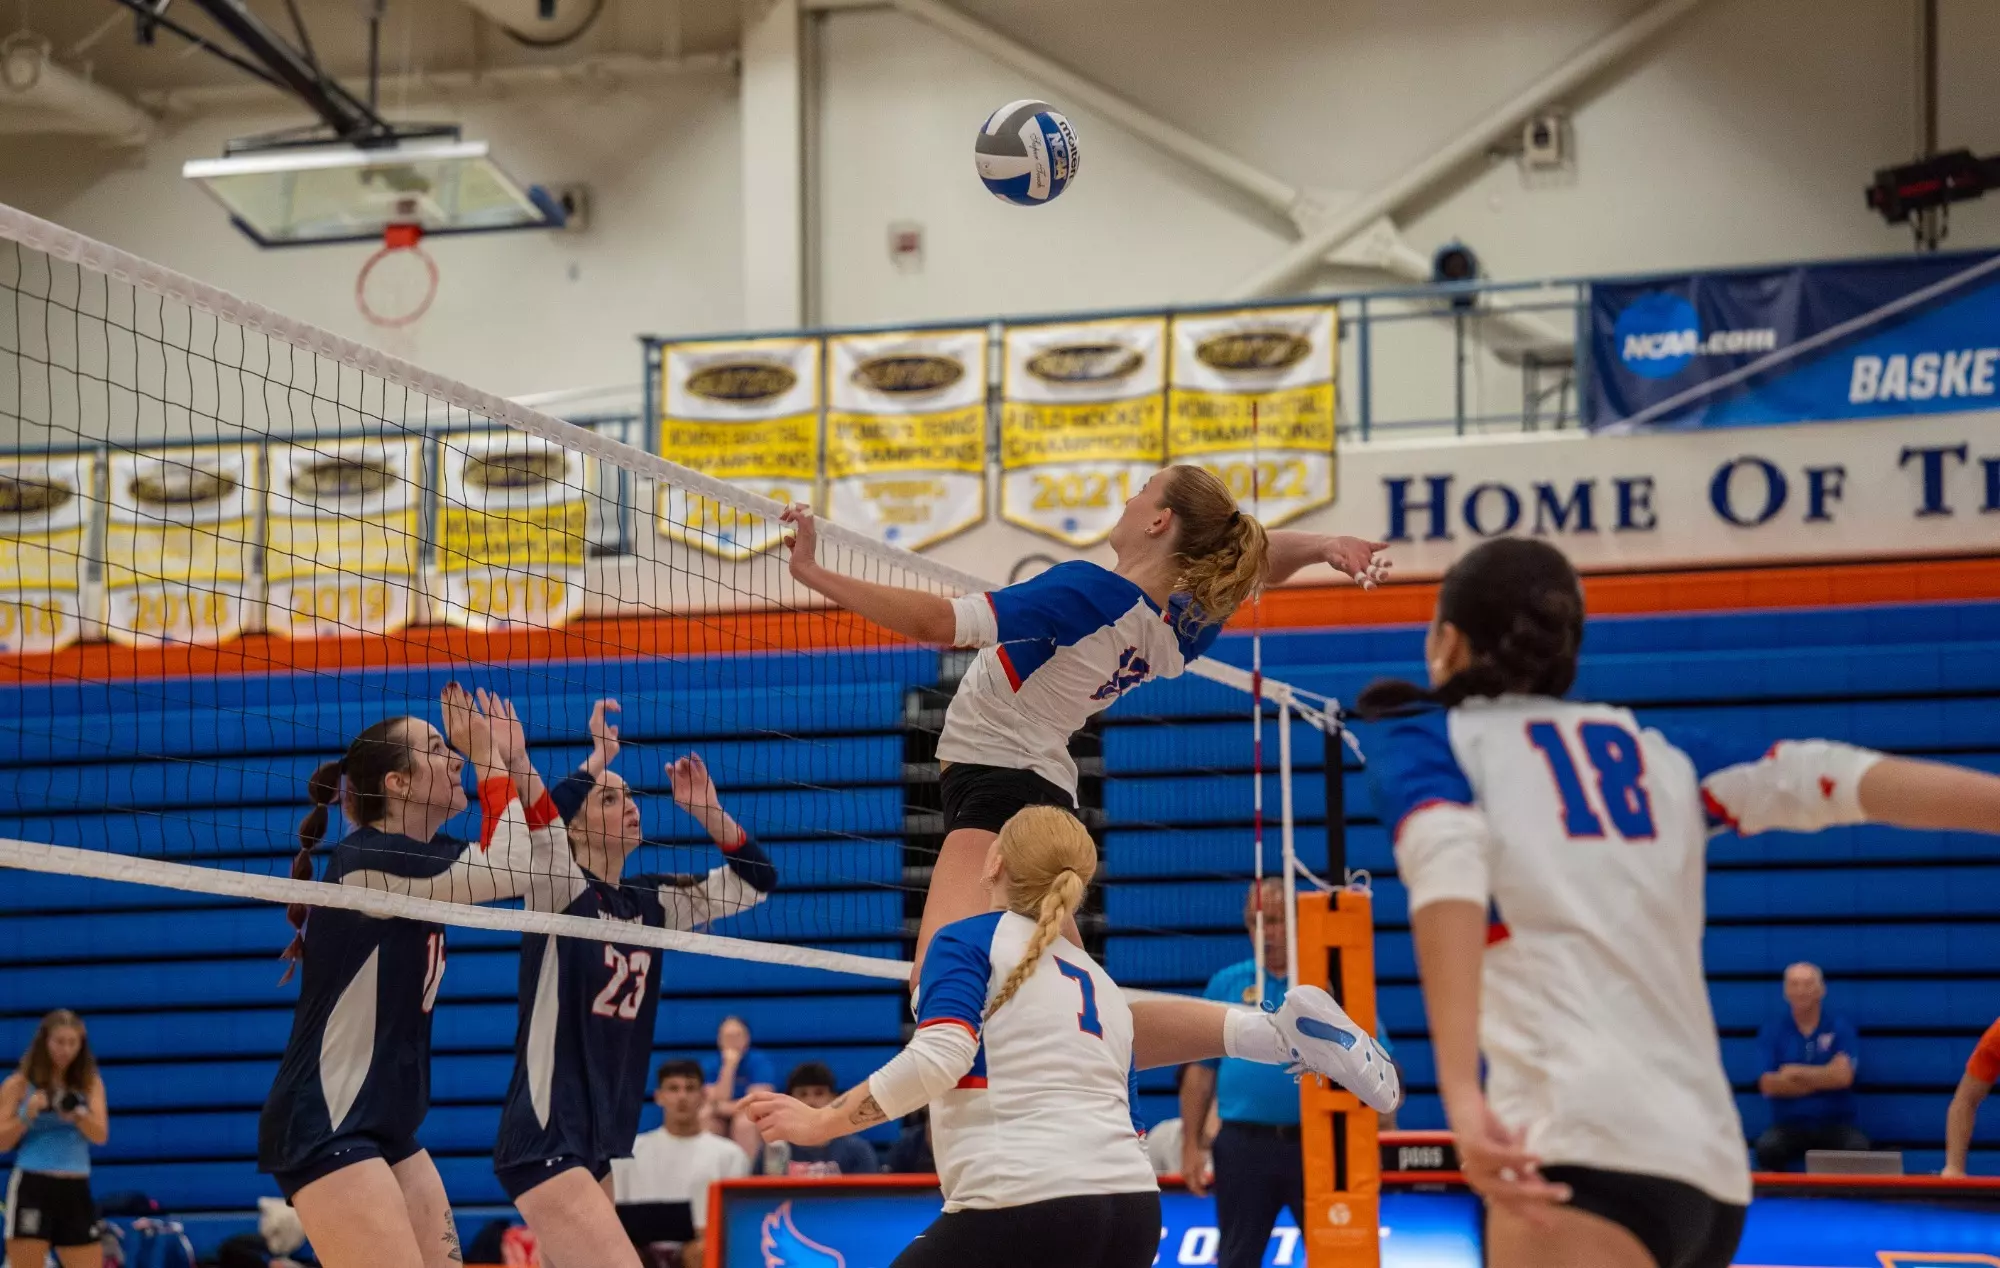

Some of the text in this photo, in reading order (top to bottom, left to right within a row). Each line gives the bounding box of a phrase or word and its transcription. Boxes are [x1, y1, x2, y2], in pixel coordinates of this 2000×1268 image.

[1060, 120, 1078, 180] molten
[1622, 327, 1777, 361] NCAA.com
[1032, 470, 1132, 511] 2021
[1381, 471, 1659, 542] HOME
[1710, 455, 1847, 529] OF
[291, 583, 393, 624] 2019
[1524, 719, 1660, 842] 18
[592, 942, 652, 1020] 23
[1052, 954, 1104, 1041] 7
